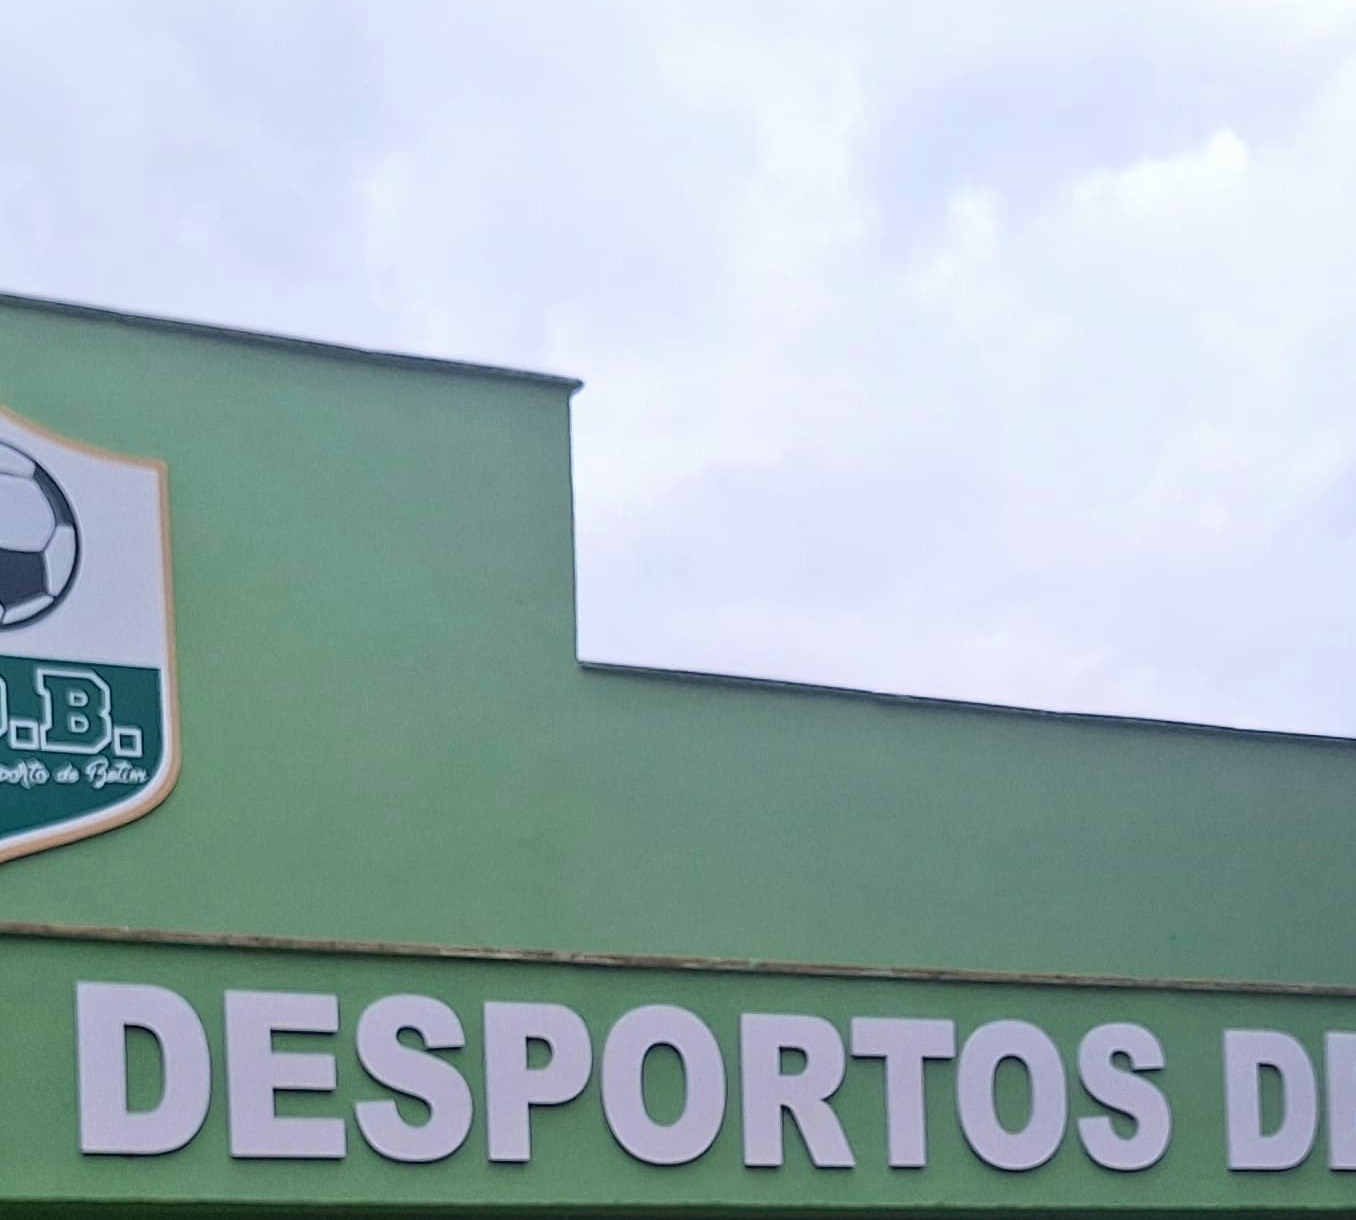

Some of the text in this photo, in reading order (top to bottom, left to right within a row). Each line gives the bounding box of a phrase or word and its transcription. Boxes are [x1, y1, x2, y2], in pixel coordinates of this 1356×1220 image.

[55, 764, 80, 783] de
[85, 756, 149, 788] Betim
[72, 978, 1173, 1170] DESPORTOS
